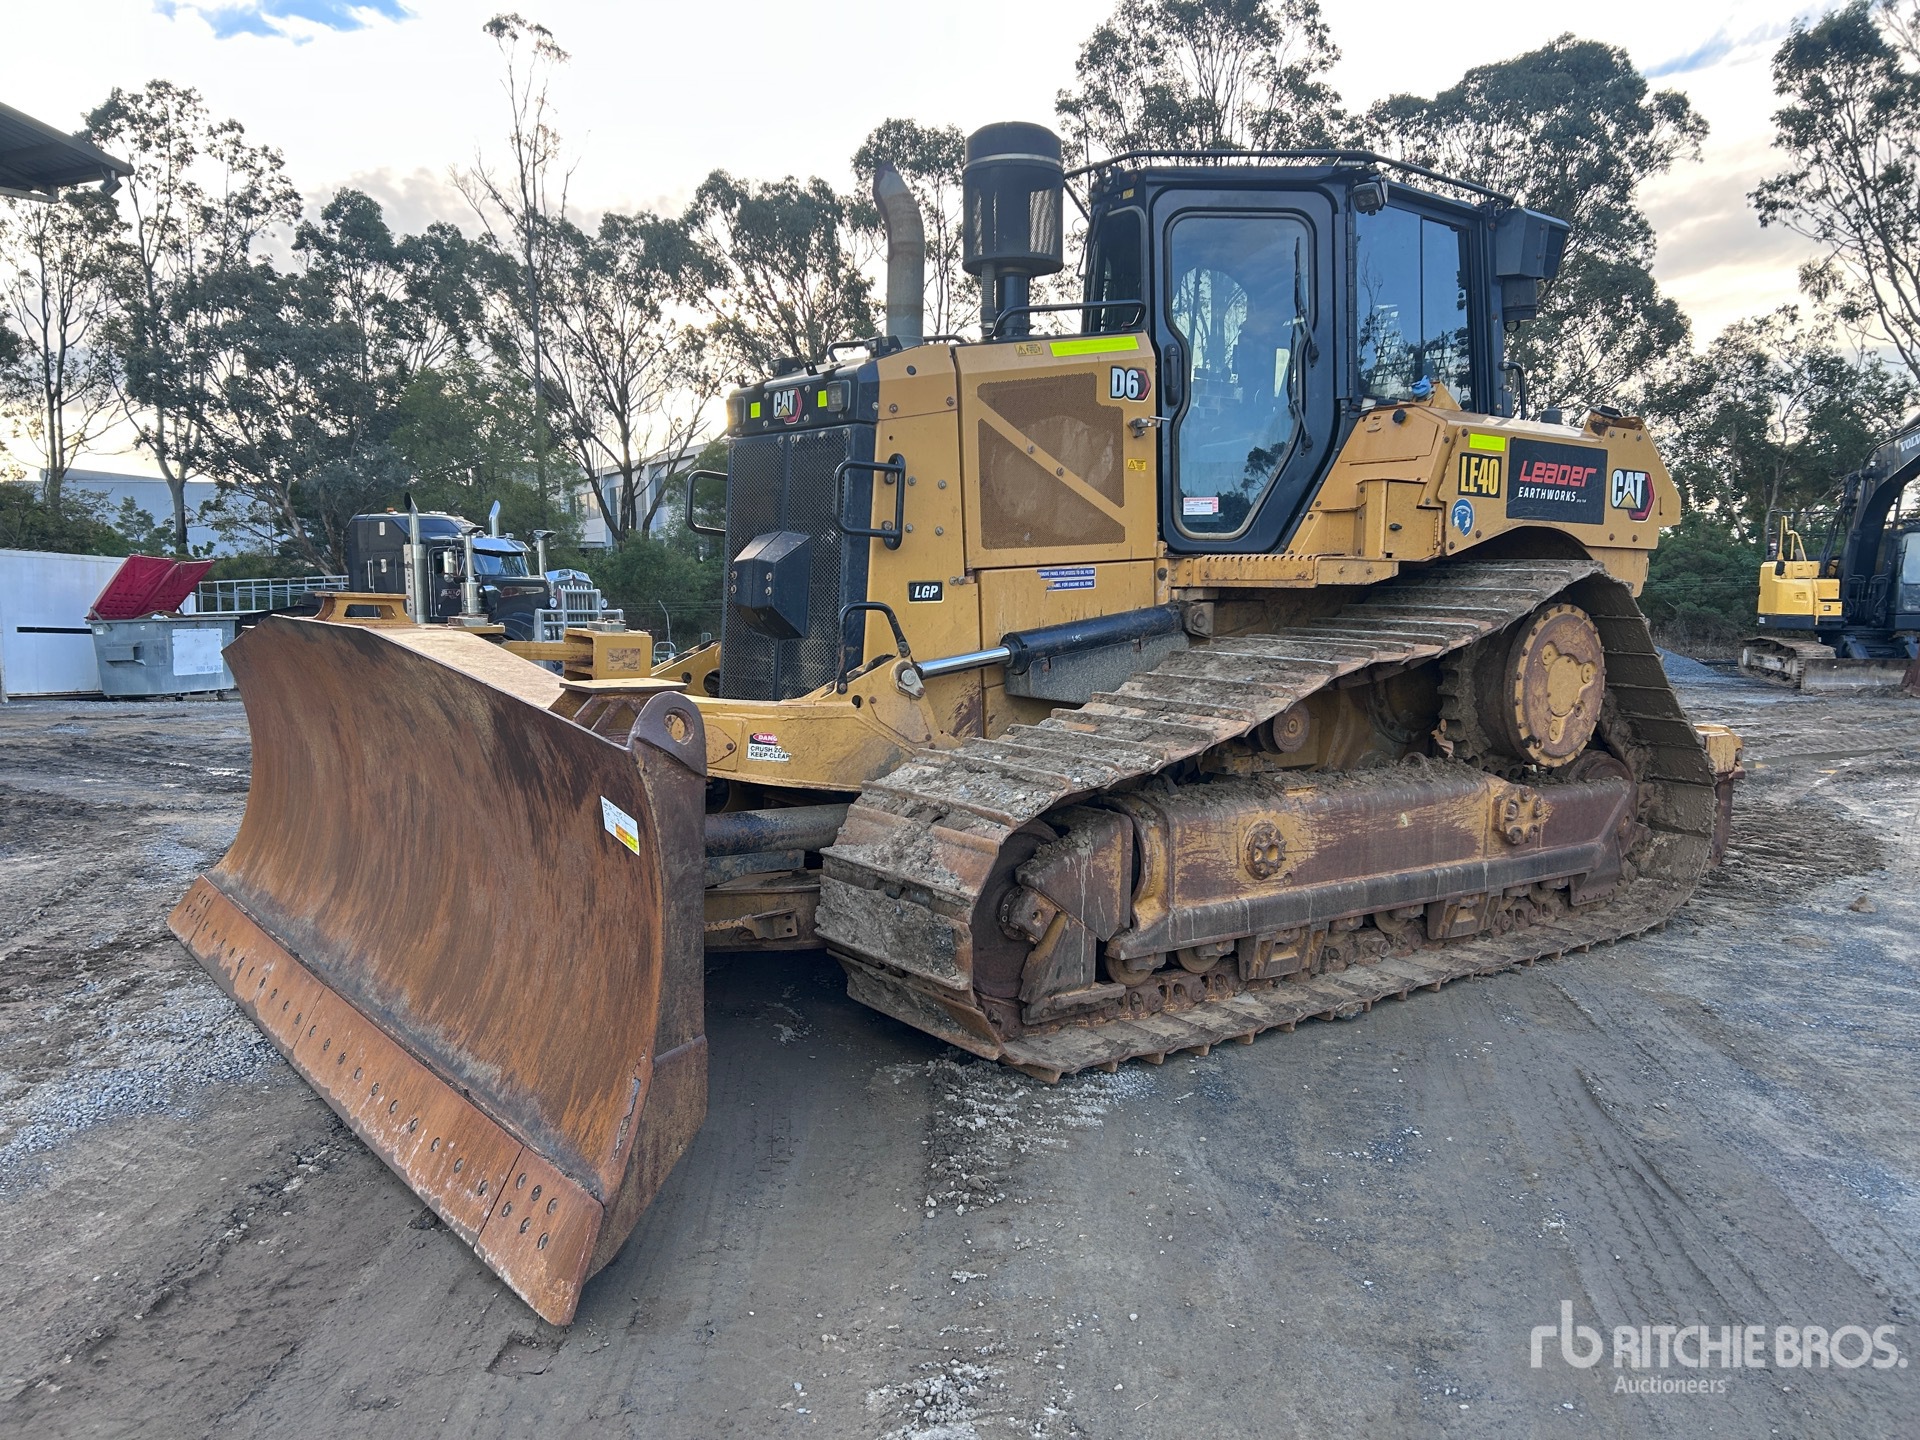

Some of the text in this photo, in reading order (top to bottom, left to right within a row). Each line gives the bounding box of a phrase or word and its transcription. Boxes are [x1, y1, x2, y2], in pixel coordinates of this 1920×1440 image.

[1111, 367, 1139, 399] D6
[773, 389, 795, 417] CAT
[1900, 433, 1920, 452] VOLV
[1460, 456, 1500, 495] LE40
[1611, 469, 1646, 509] CAT
[1518, 486, 1577, 503] EARTHWORKS
[914, 585, 939, 599] LGP
